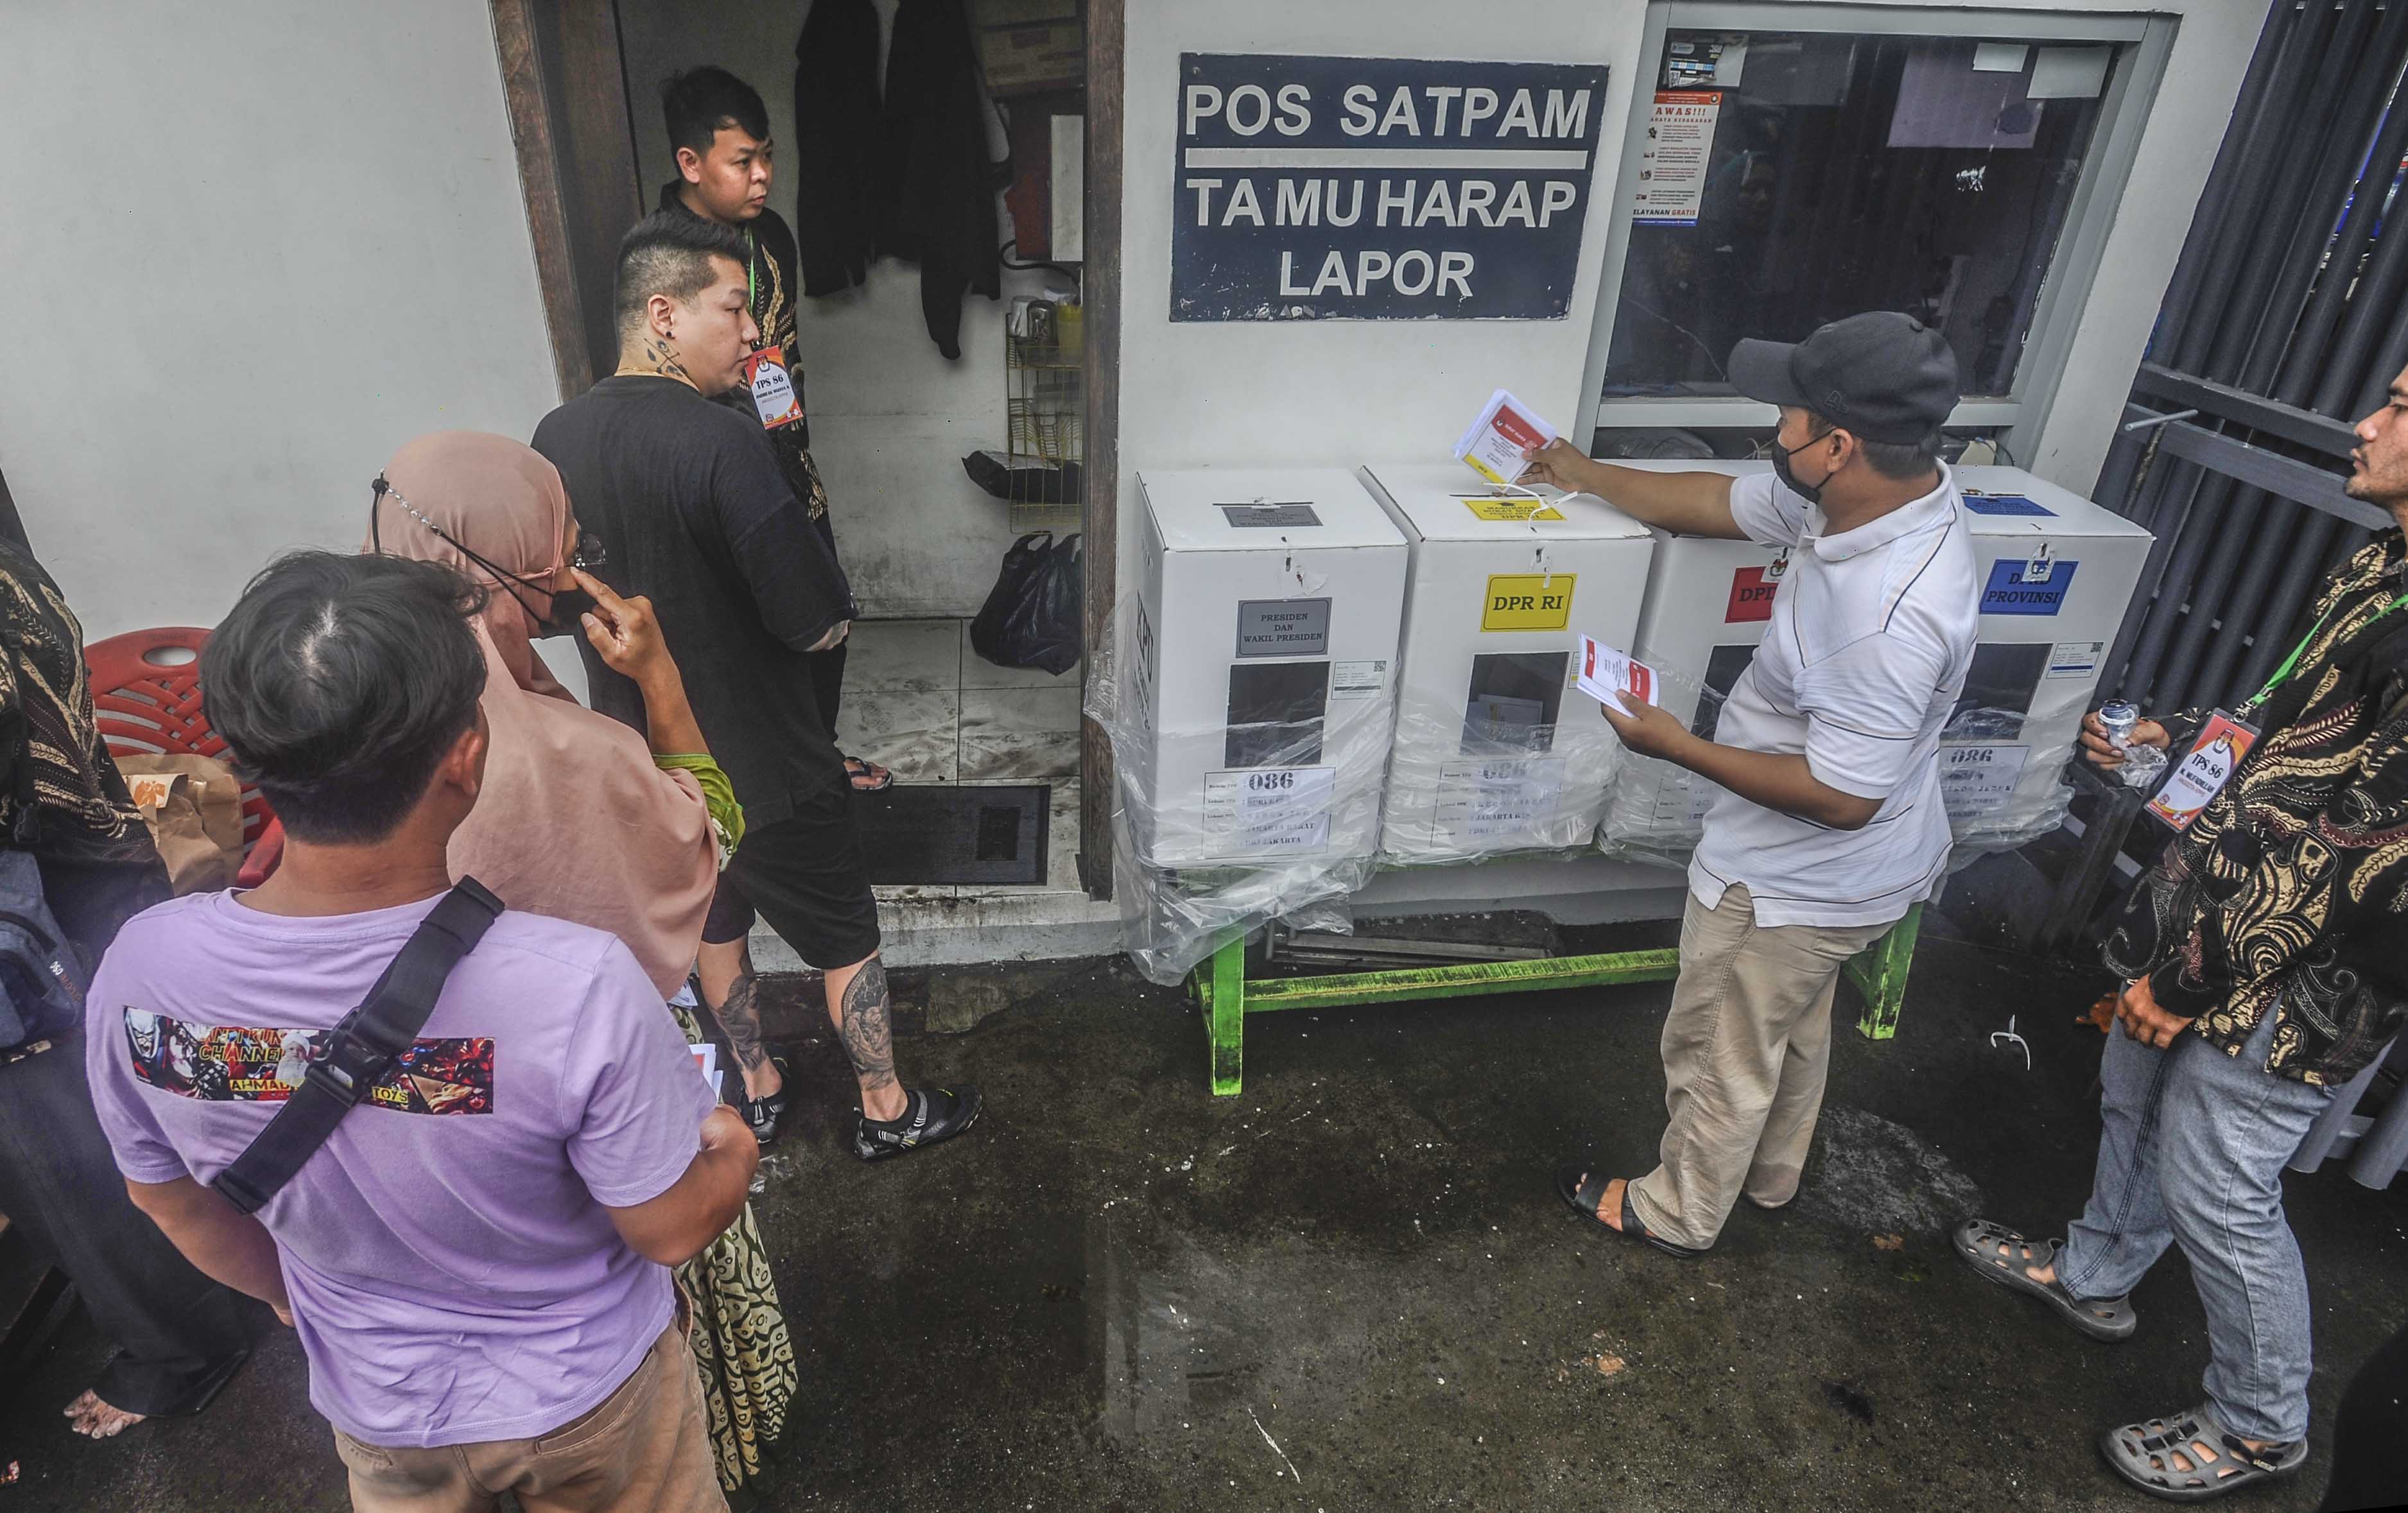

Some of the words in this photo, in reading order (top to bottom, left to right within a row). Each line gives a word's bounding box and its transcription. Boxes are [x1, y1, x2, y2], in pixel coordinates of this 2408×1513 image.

[1186, 84, 1311, 136] POS
[1340, 86, 1591, 139] SATPAM
[1655, 107, 1706, 116] AWAS!!!
[1376, 179, 1577, 228] HARAP
[1279, 250, 1475, 298] LAPOR
[756, 377, 771, 390] TPS
[772, 374, 784, 385] 86
[1493, 596, 1535, 610] DPR
[1541, 596, 1564, 610] RI
[1986, 591, 2060, 604] PROVINSI
[1261, 612, 1308, 622] PRESIDEN
[1137, 589, 1154, 684] KPU
[1276, 632, 1322, 641] PRESIDEN
[2192, 753, 2210, 771] TPS
[2208, 764, 2224, 779] 86
[1249, 772, 1294, 791] 086
[374, 1087, 408, 1102] TOYS
